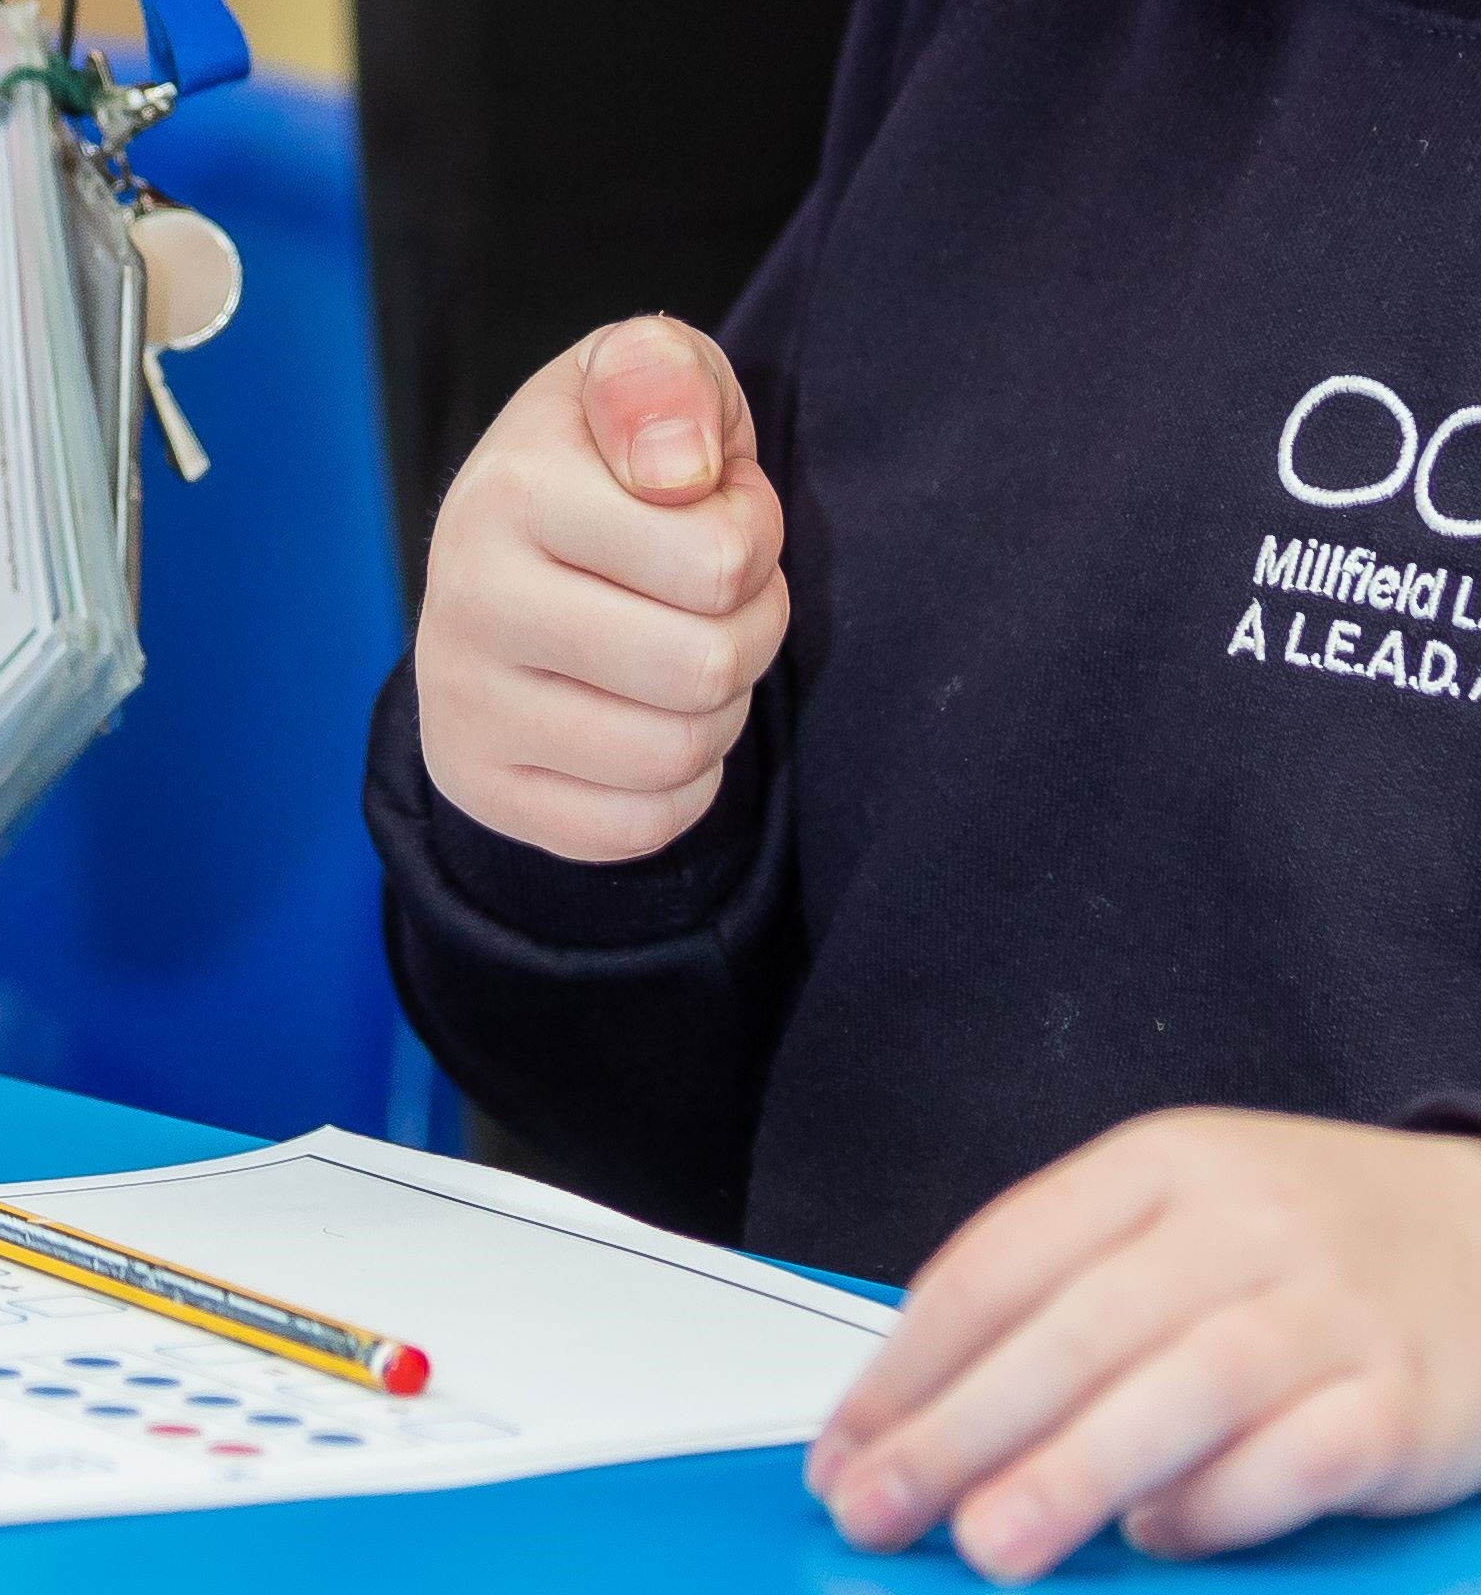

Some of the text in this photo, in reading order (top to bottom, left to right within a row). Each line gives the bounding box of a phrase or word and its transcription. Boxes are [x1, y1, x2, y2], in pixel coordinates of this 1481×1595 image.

[1253, 535, 1447, 621] Millfield
[1227, 597, 1266, 662] A
[1285, 611, 1461, 699] L.E.A.D.
